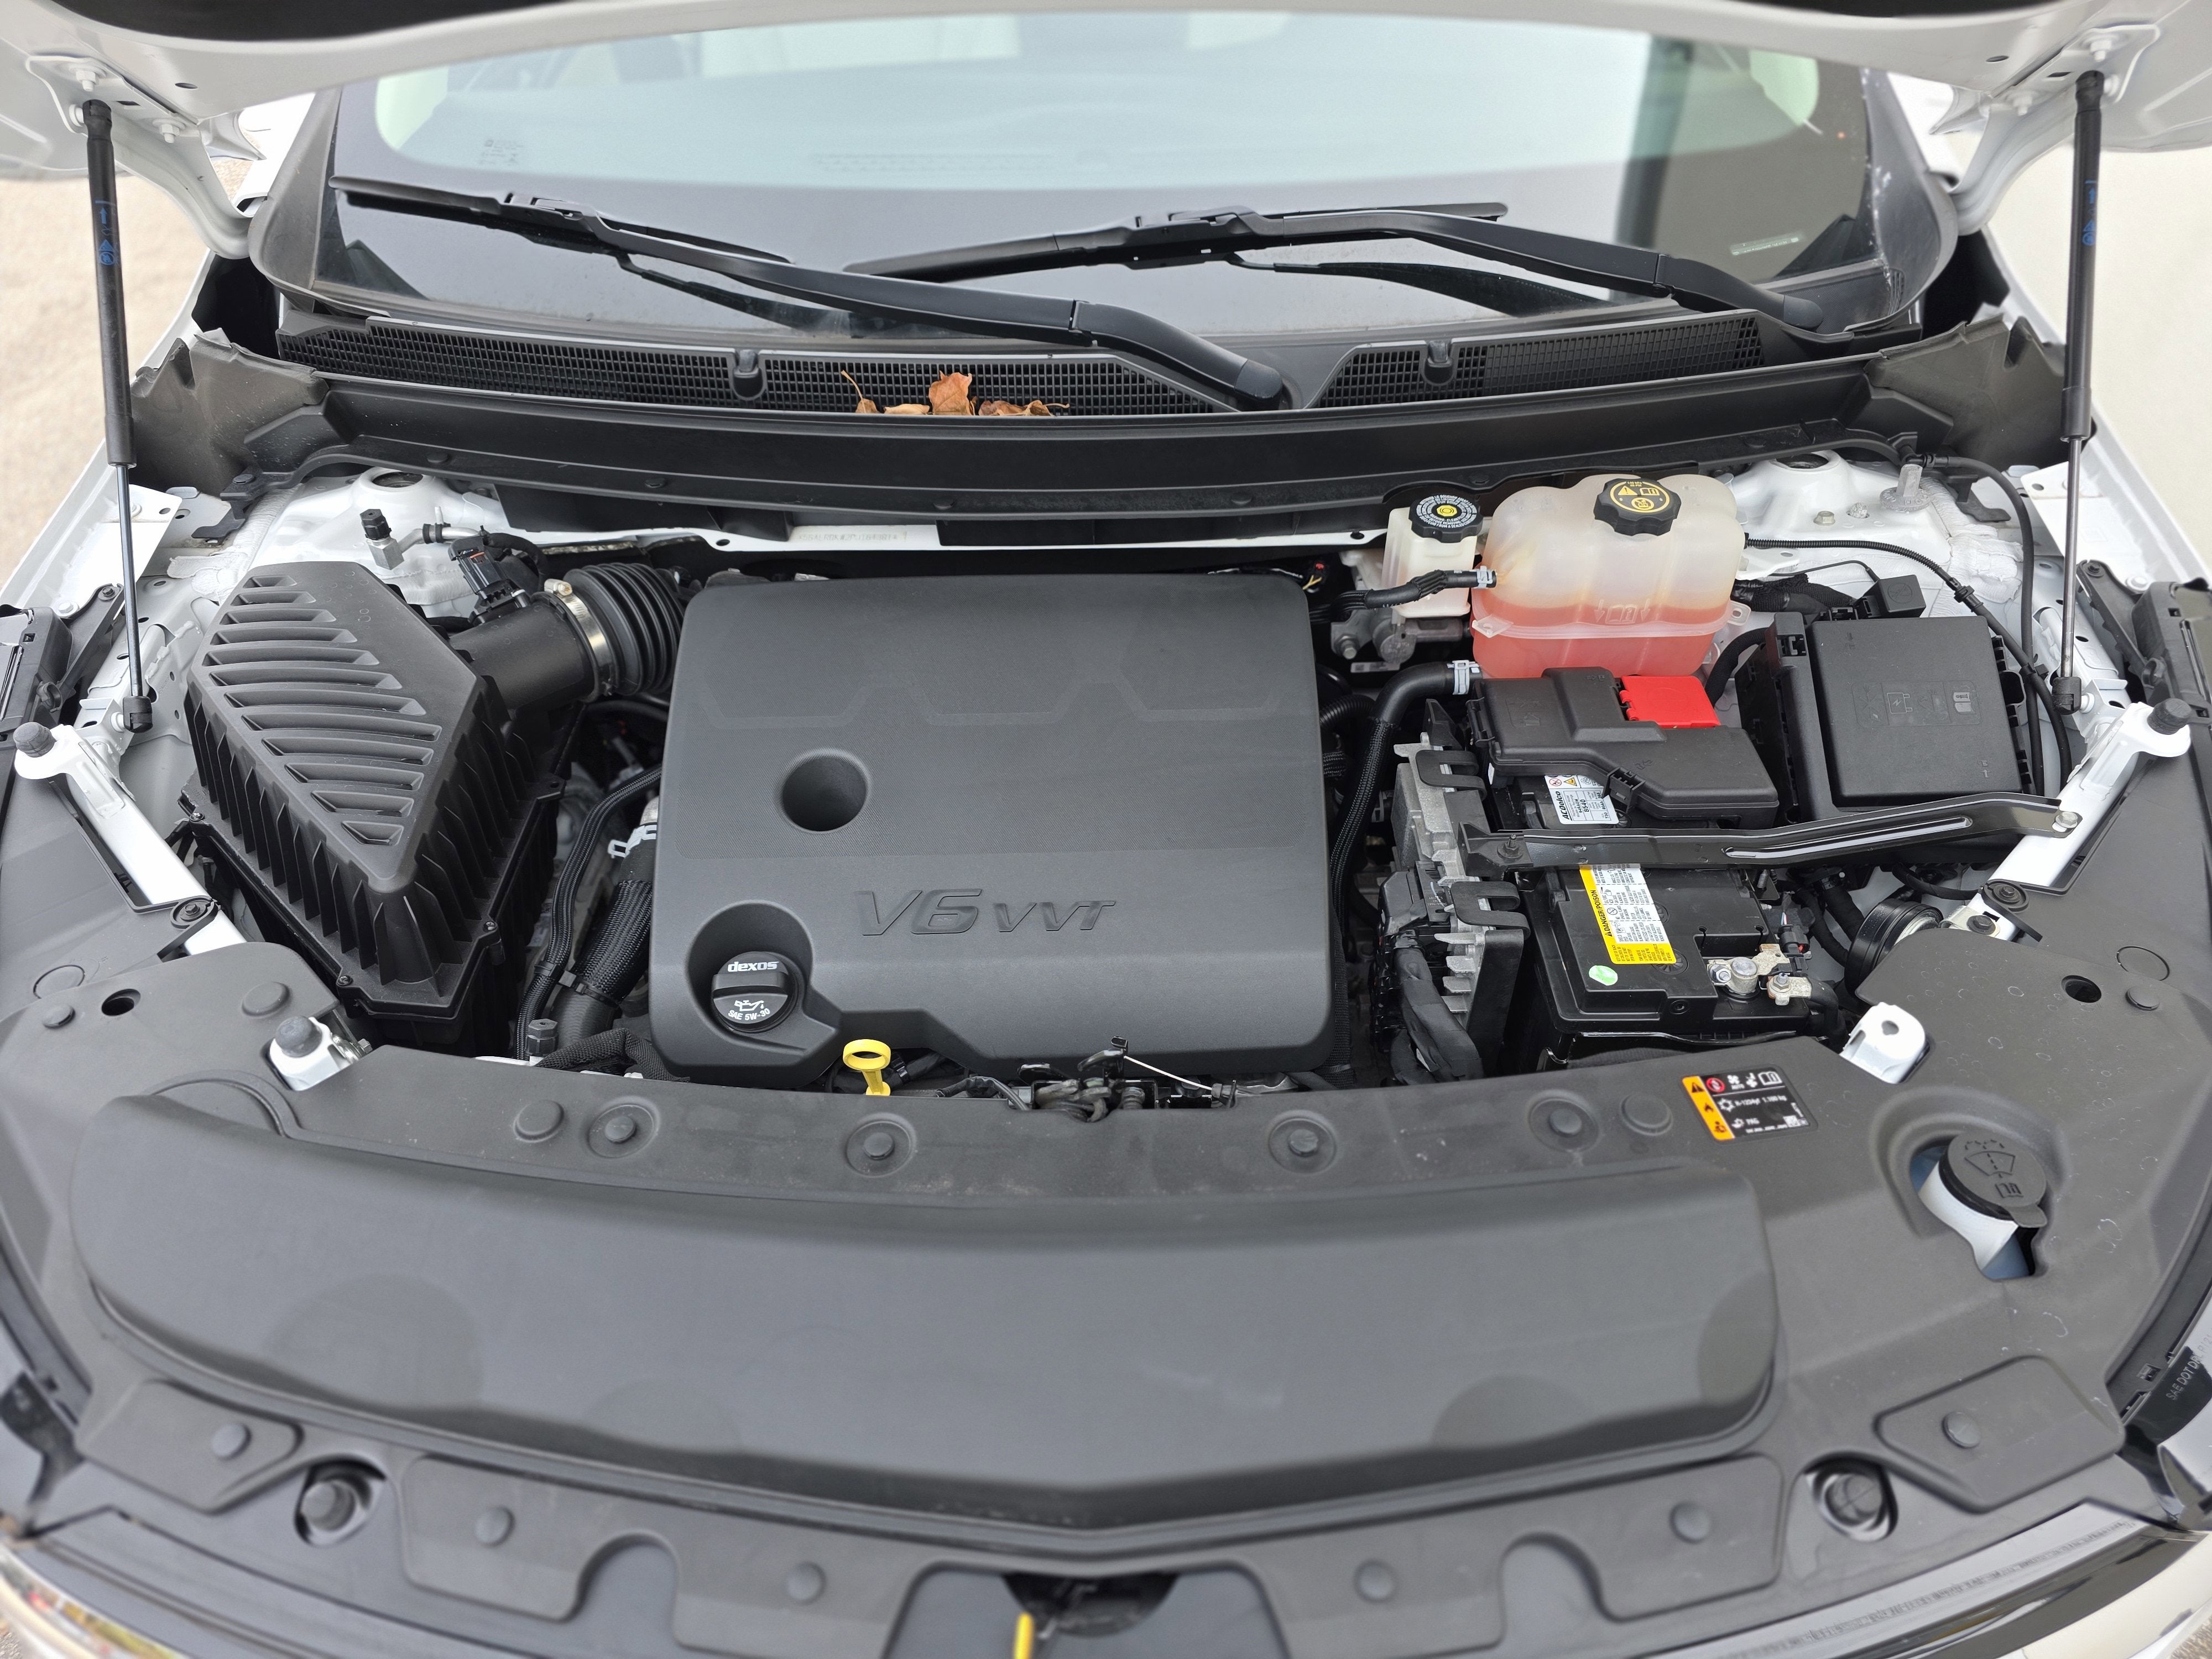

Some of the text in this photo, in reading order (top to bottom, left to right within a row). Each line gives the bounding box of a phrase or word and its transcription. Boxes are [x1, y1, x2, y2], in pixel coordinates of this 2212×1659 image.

[1555, 791, 1569, 820] ACDelco
[1580, 799, 1589, 812] 8540
[854, 888, 1117, 937] V6 VVT
[1590, 890, 1610, 931] DANGER/POISON
[728, 961, 779, 972] dexos
[728, 1008, 770, 1020] SAE 5W-30
[2166, 1383, 2184, 1401] SAE
[2177, 1366, 2194, 1385] DOT
